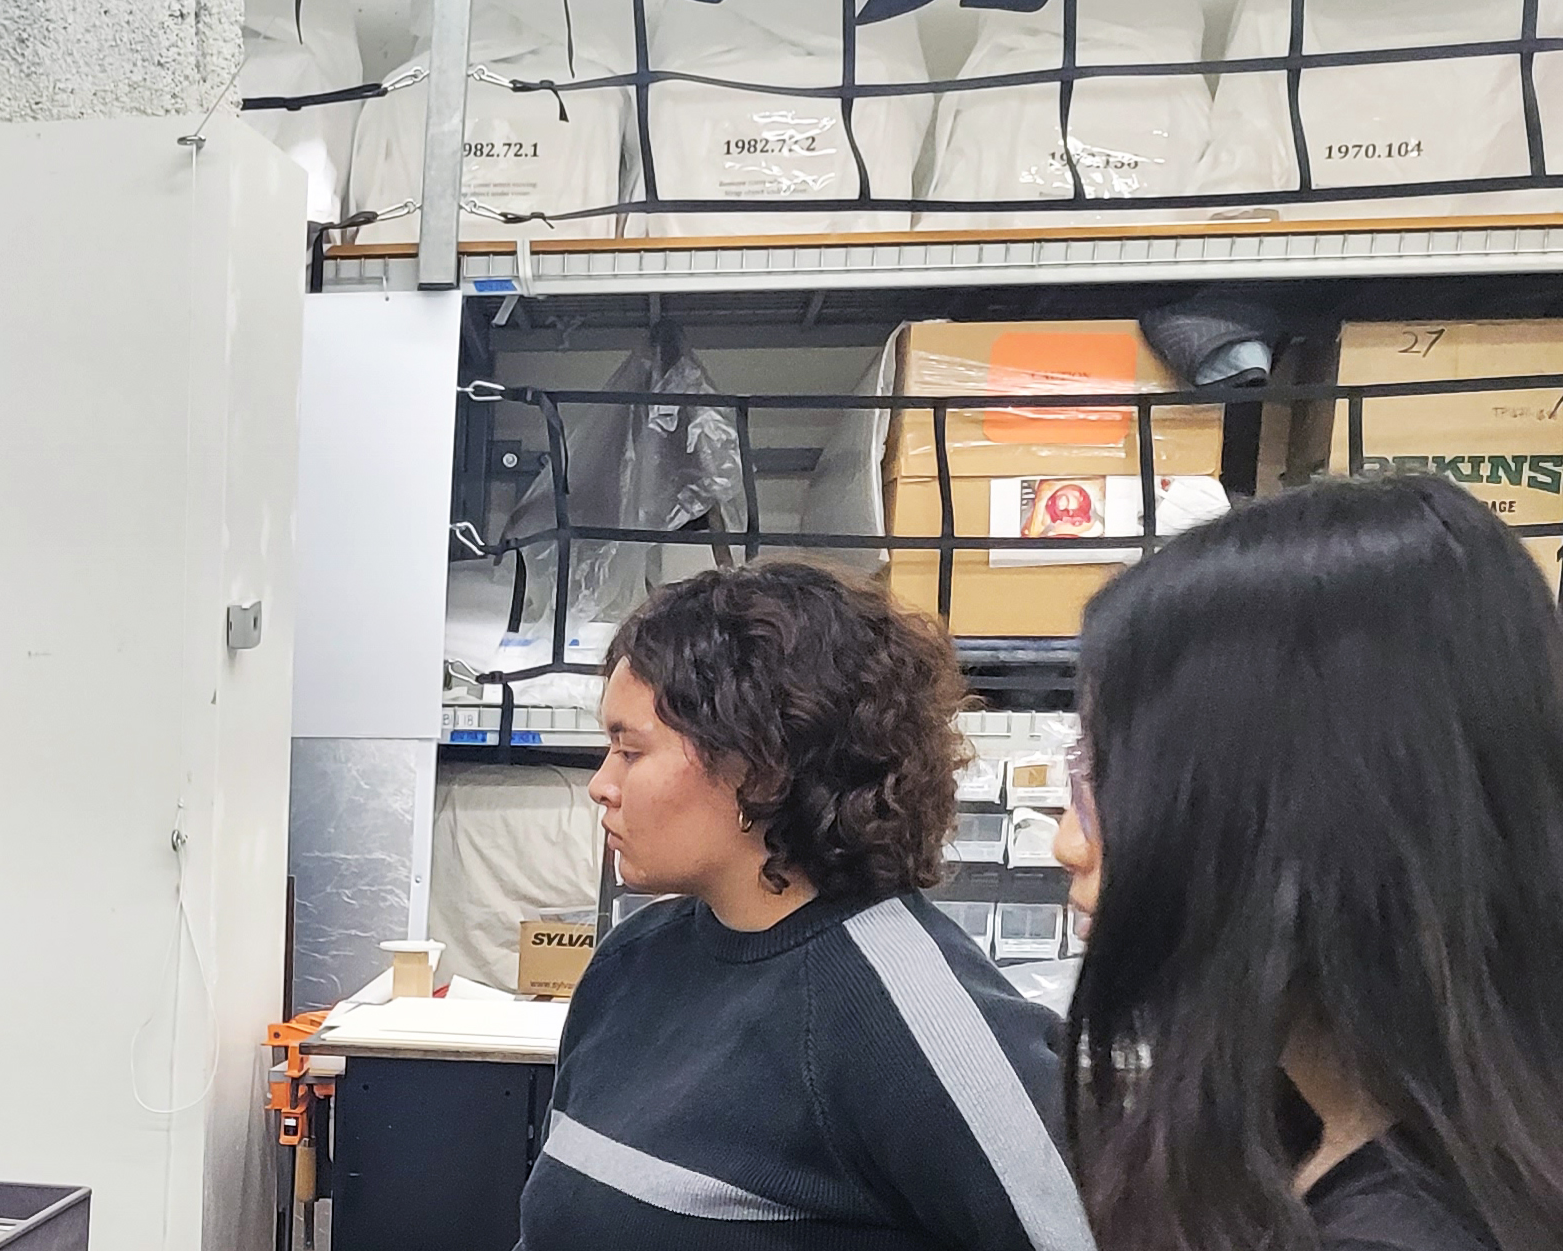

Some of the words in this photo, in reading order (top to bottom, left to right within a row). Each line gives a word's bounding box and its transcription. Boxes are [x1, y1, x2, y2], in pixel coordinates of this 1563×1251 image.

[463, 142, 540, 158] 982.72.1
[724, 136, 816, 155] 1982.72
[1325, 140, 1424, 160] 1970.104
[1398, 328, 1445, 357] 27
[1486, 501, 1517, 513] AGE
[531, 933, 594, 948] SYLVA
